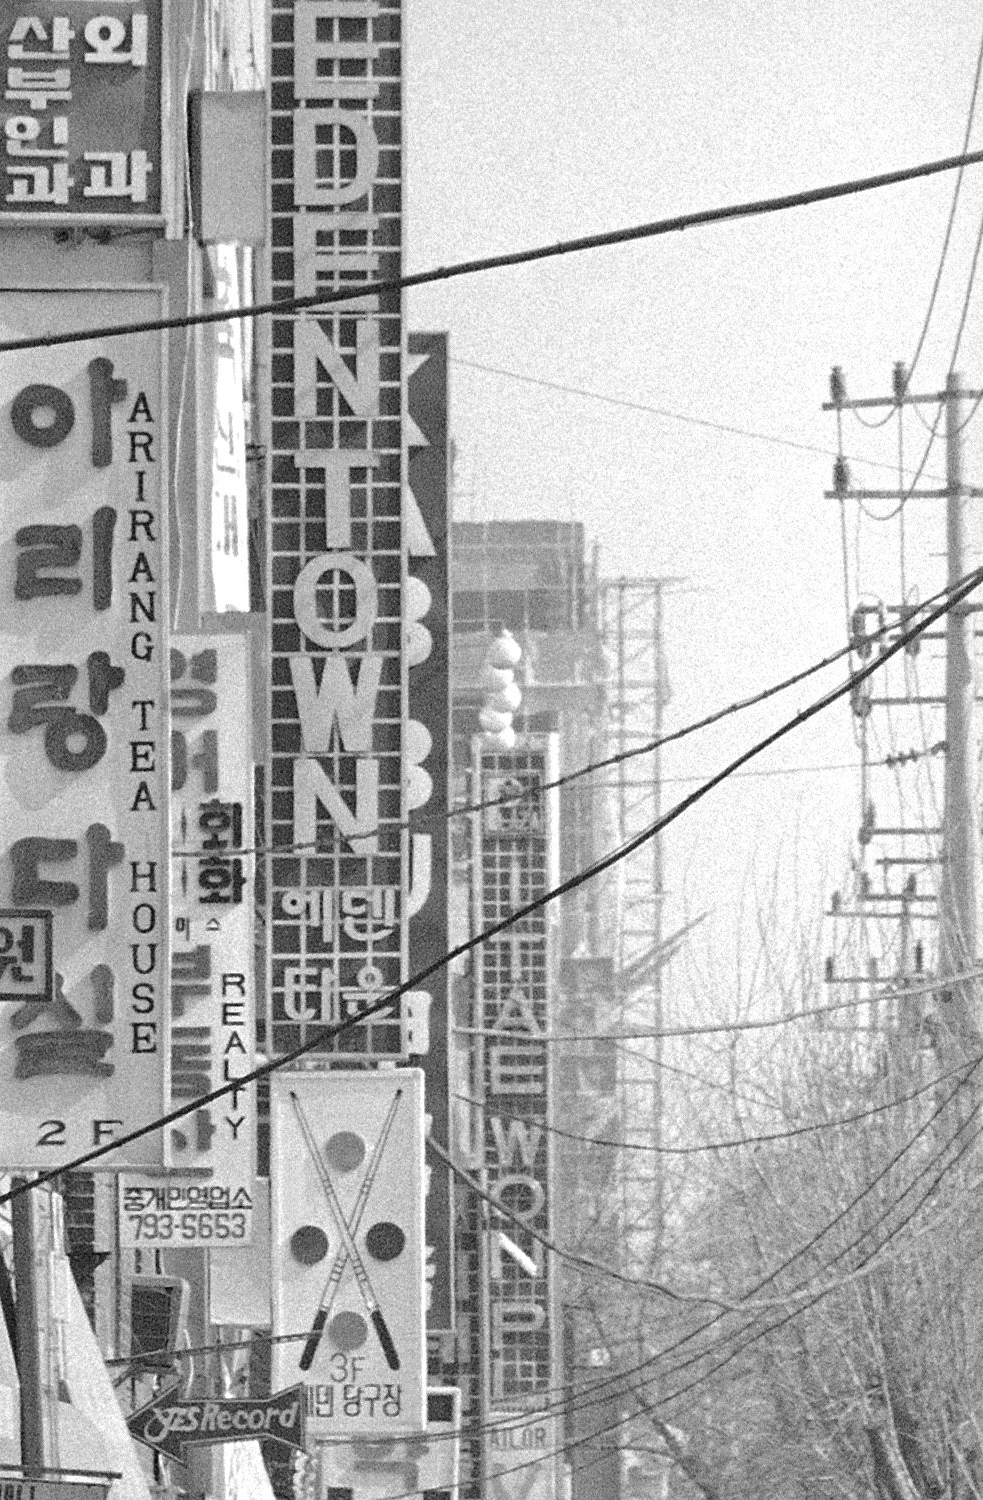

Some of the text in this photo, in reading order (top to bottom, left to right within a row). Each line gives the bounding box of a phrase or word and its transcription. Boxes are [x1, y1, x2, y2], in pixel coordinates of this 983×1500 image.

[4, 16, 75, 204] 산부인과
[127, 391, 158, 1054] ARIRANG TEA HOUSE
[281, 887, 395, 942] 에덴
[284, 964, 399, 1023] 타운
[221, 973, 248, 1139] REALTY
[128, 1213, 246, 1240] 793-5653
[330, 1352, 365, 1382] 3F
[343, 1384, 402, 1417] 당구장
